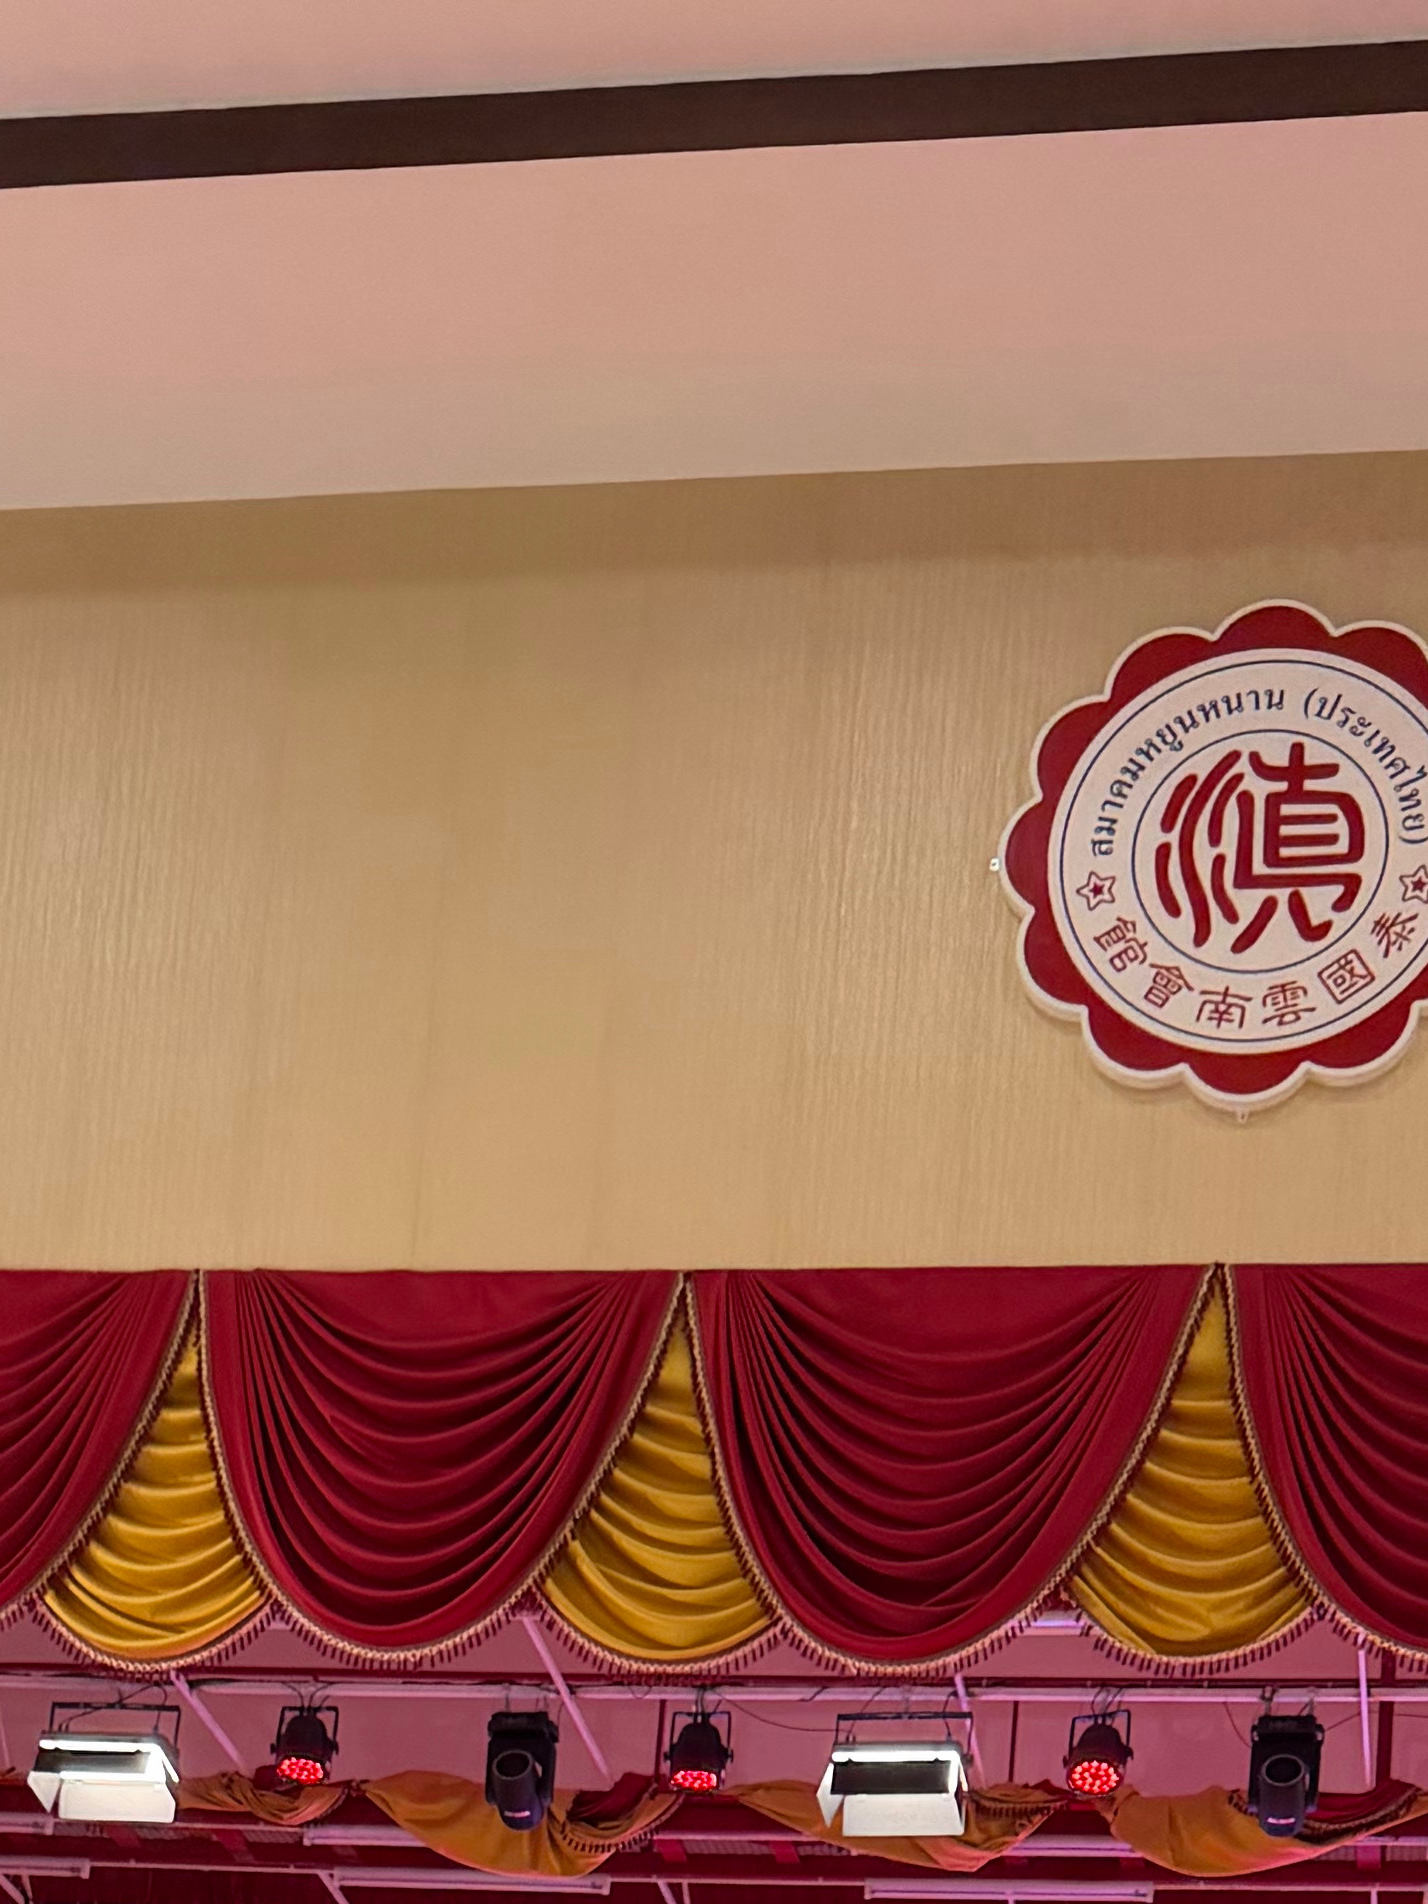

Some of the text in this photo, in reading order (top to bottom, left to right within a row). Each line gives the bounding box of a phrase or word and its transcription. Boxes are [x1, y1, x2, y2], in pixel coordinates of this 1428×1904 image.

[1090, 687, 1285, 857] สมาคมหยูนหนาน
